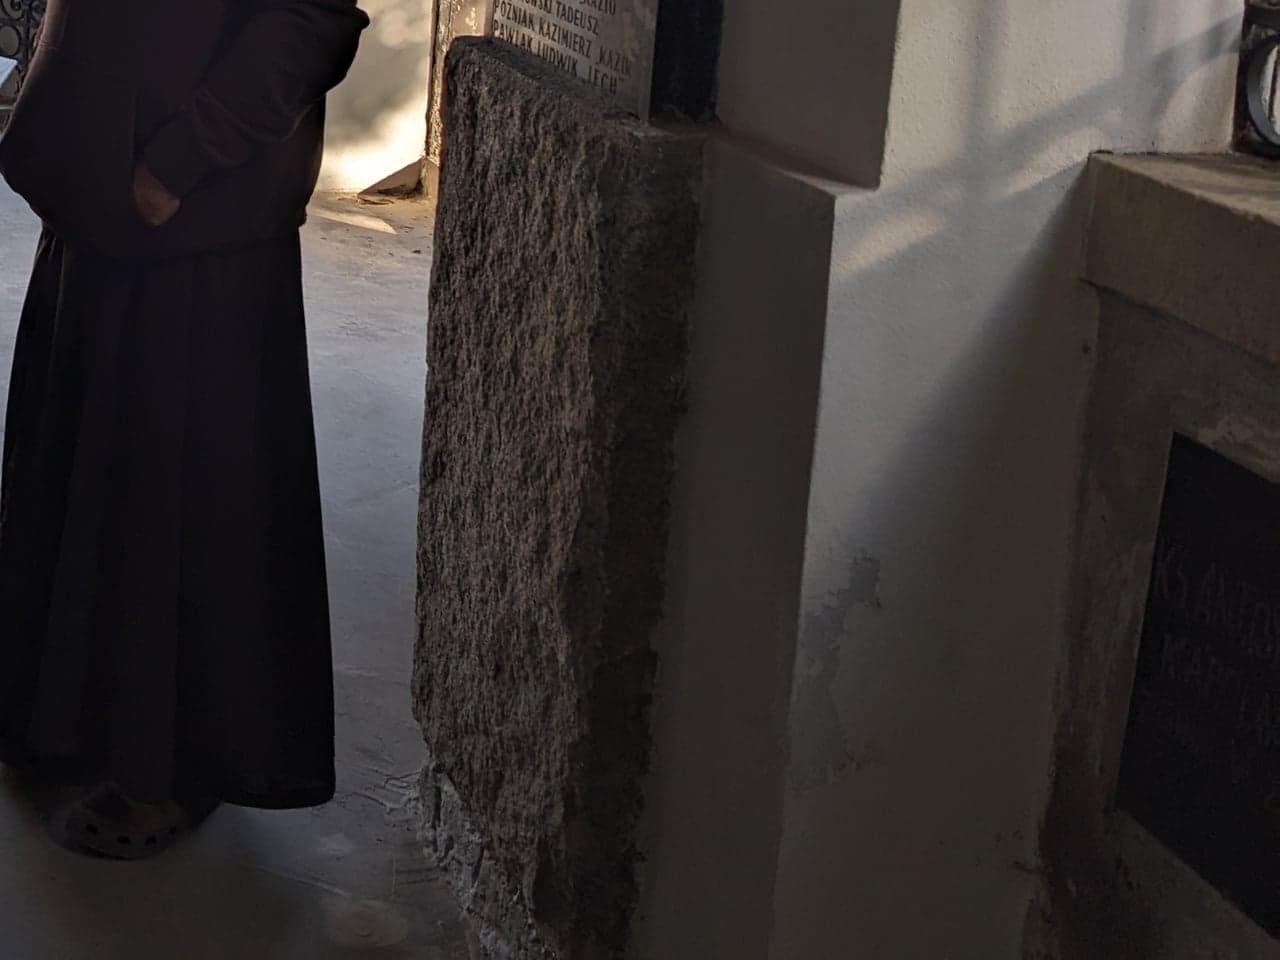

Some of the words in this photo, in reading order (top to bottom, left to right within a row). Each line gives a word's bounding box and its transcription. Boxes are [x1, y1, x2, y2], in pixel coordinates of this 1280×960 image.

[557, 1, 599, 36] TADEUSZ
[539, 18, 592, 58] KAZIMIERZ
[536, 41, 578, 76] LUDWIK
